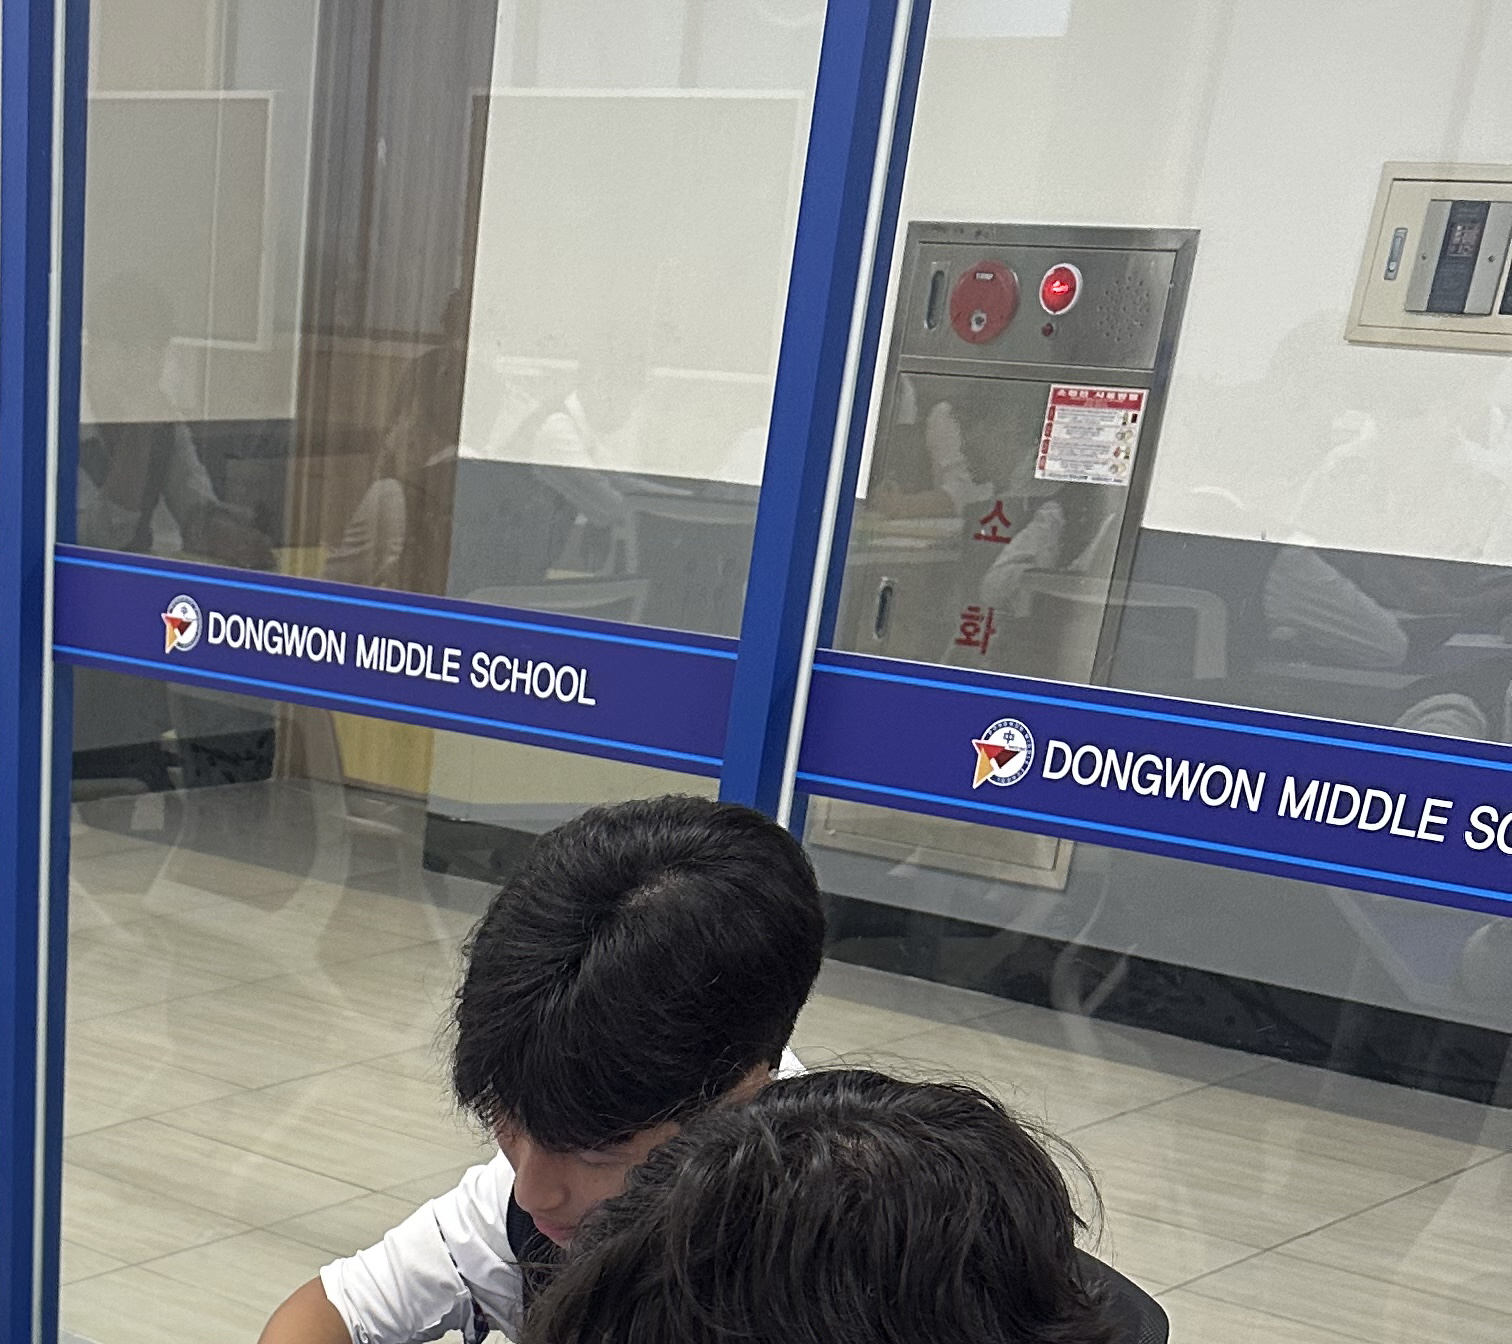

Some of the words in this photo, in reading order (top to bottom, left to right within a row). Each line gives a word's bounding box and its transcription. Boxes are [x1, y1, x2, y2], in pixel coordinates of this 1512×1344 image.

[208, 612, 346, 664] DONGWON
[356, 634, 461, 683] MIDDLE
[471, 652, 595, 705] SCHOOL
[1043, 740, 1266, 811] DONGWON
[1278, 776, 1453, 842] MIDDLE
